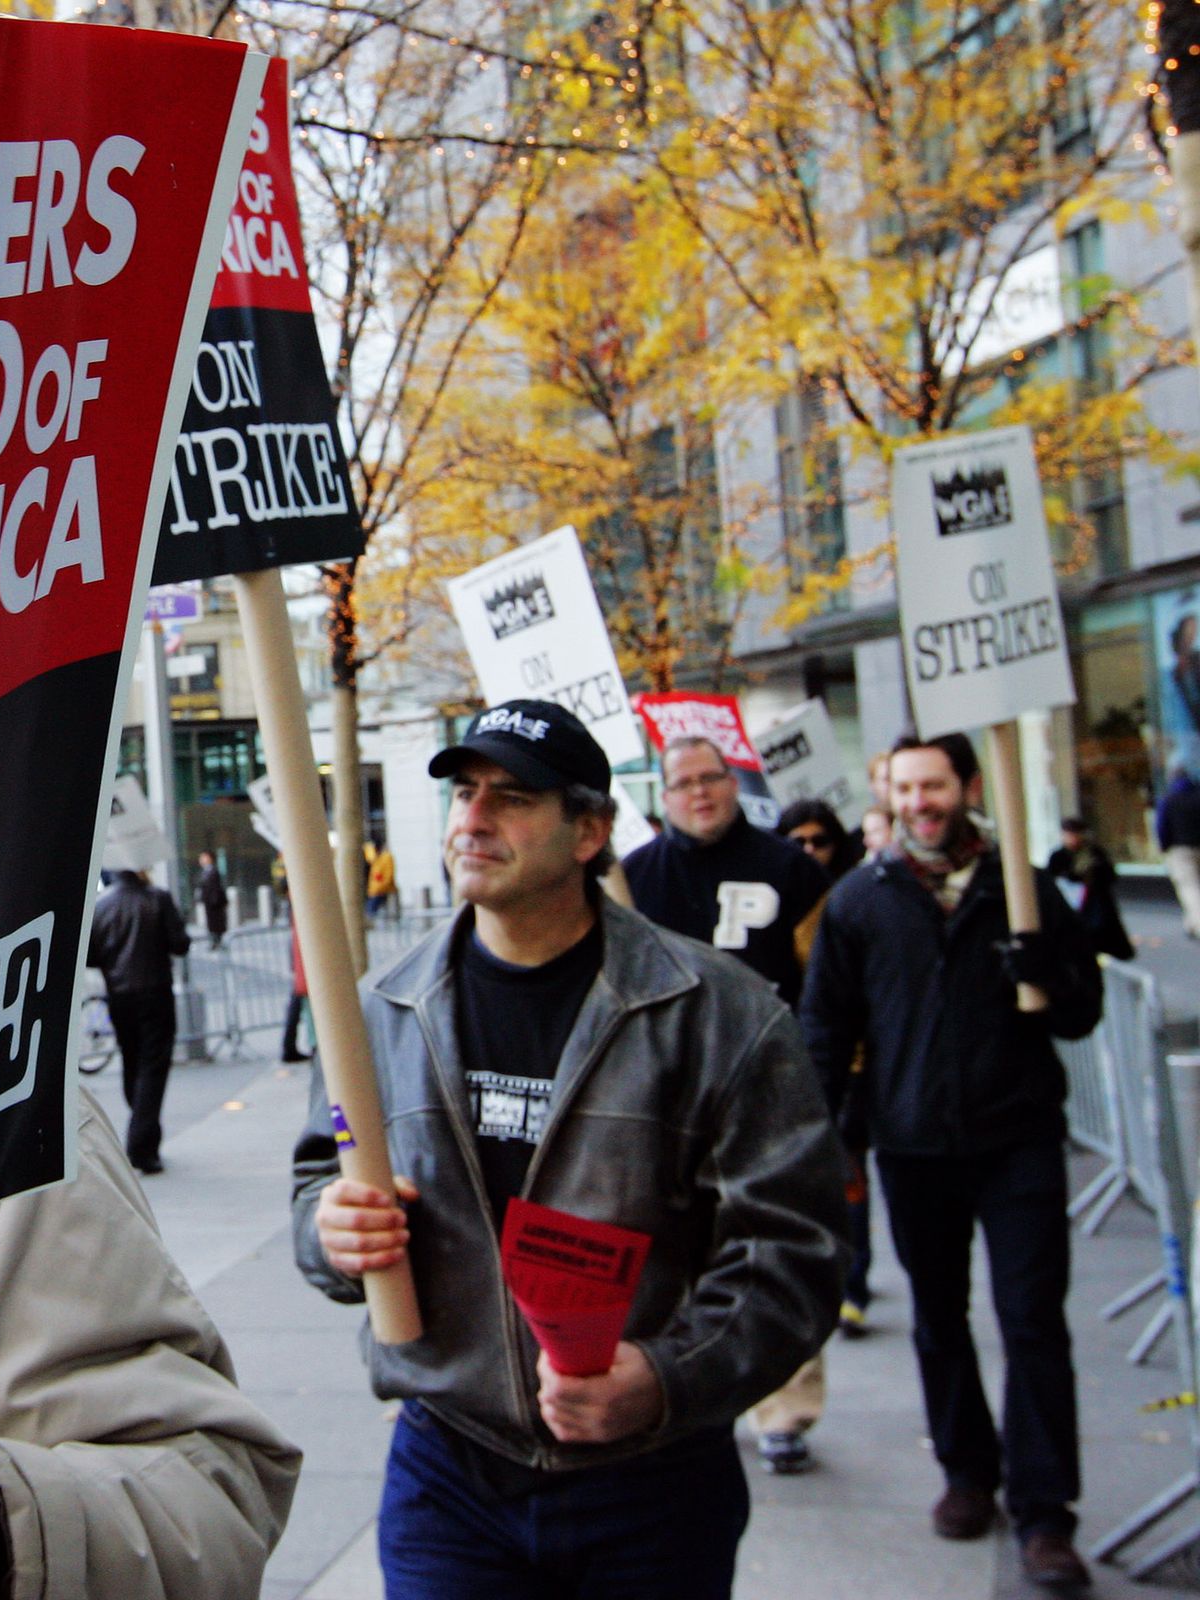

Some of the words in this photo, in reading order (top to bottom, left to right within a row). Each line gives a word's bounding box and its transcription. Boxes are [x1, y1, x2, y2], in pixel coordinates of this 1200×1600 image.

[239, 174, 274, 214] OF
[217, 217, 298, 278] RICA
[24, 338, 109, 455] OF
[192, 341, 262, 413] ON
[170, 422, 348, 535] TRIKE
[968, 560, 1007, 604] ON
[520, 652, 554, 690] ON
[915, 597, 1059, 682] STRIKE
[713, 880, 780, 950] P
